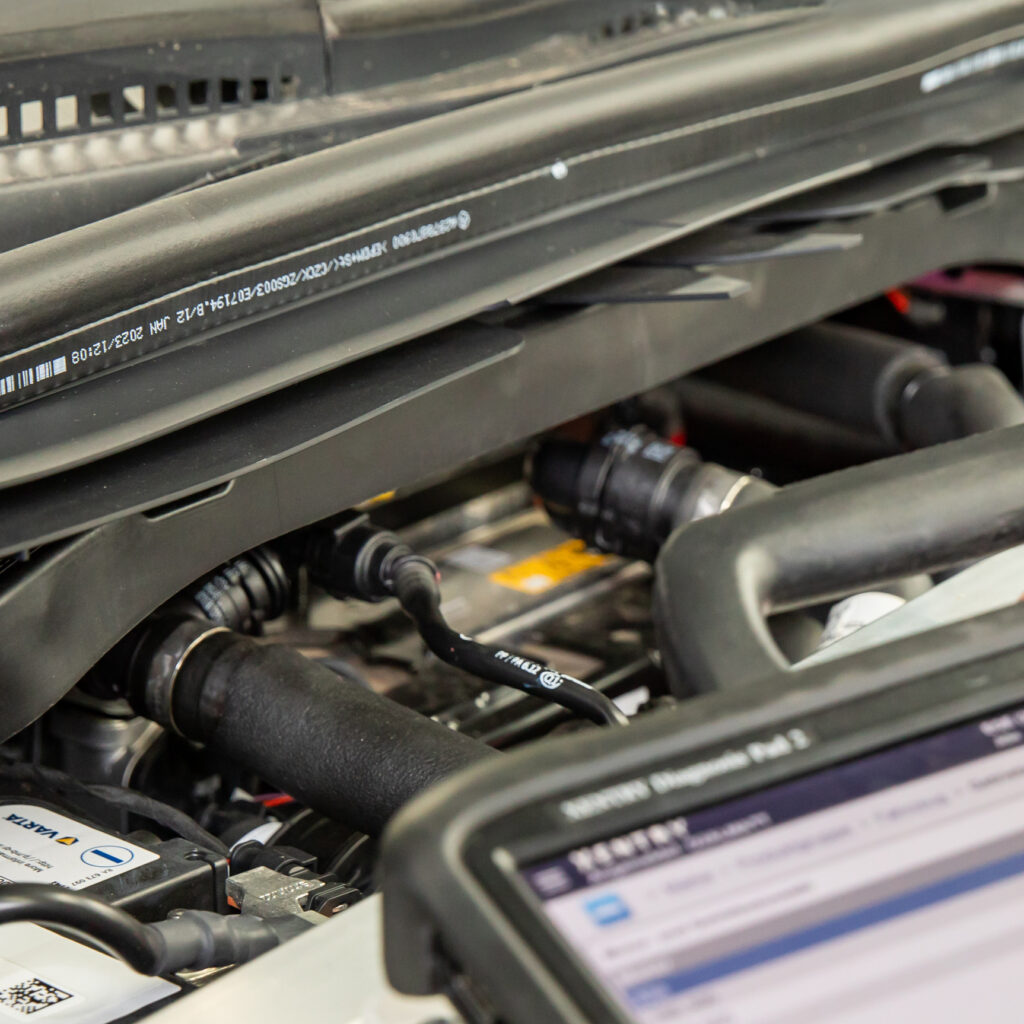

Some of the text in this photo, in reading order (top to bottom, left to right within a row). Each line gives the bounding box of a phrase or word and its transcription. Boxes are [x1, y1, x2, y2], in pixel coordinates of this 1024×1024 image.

[150, 316, 170, 335] JAN
[71, 326, 144, 365] 2023/12:08
[6, 813, 58, 838] VARTA
